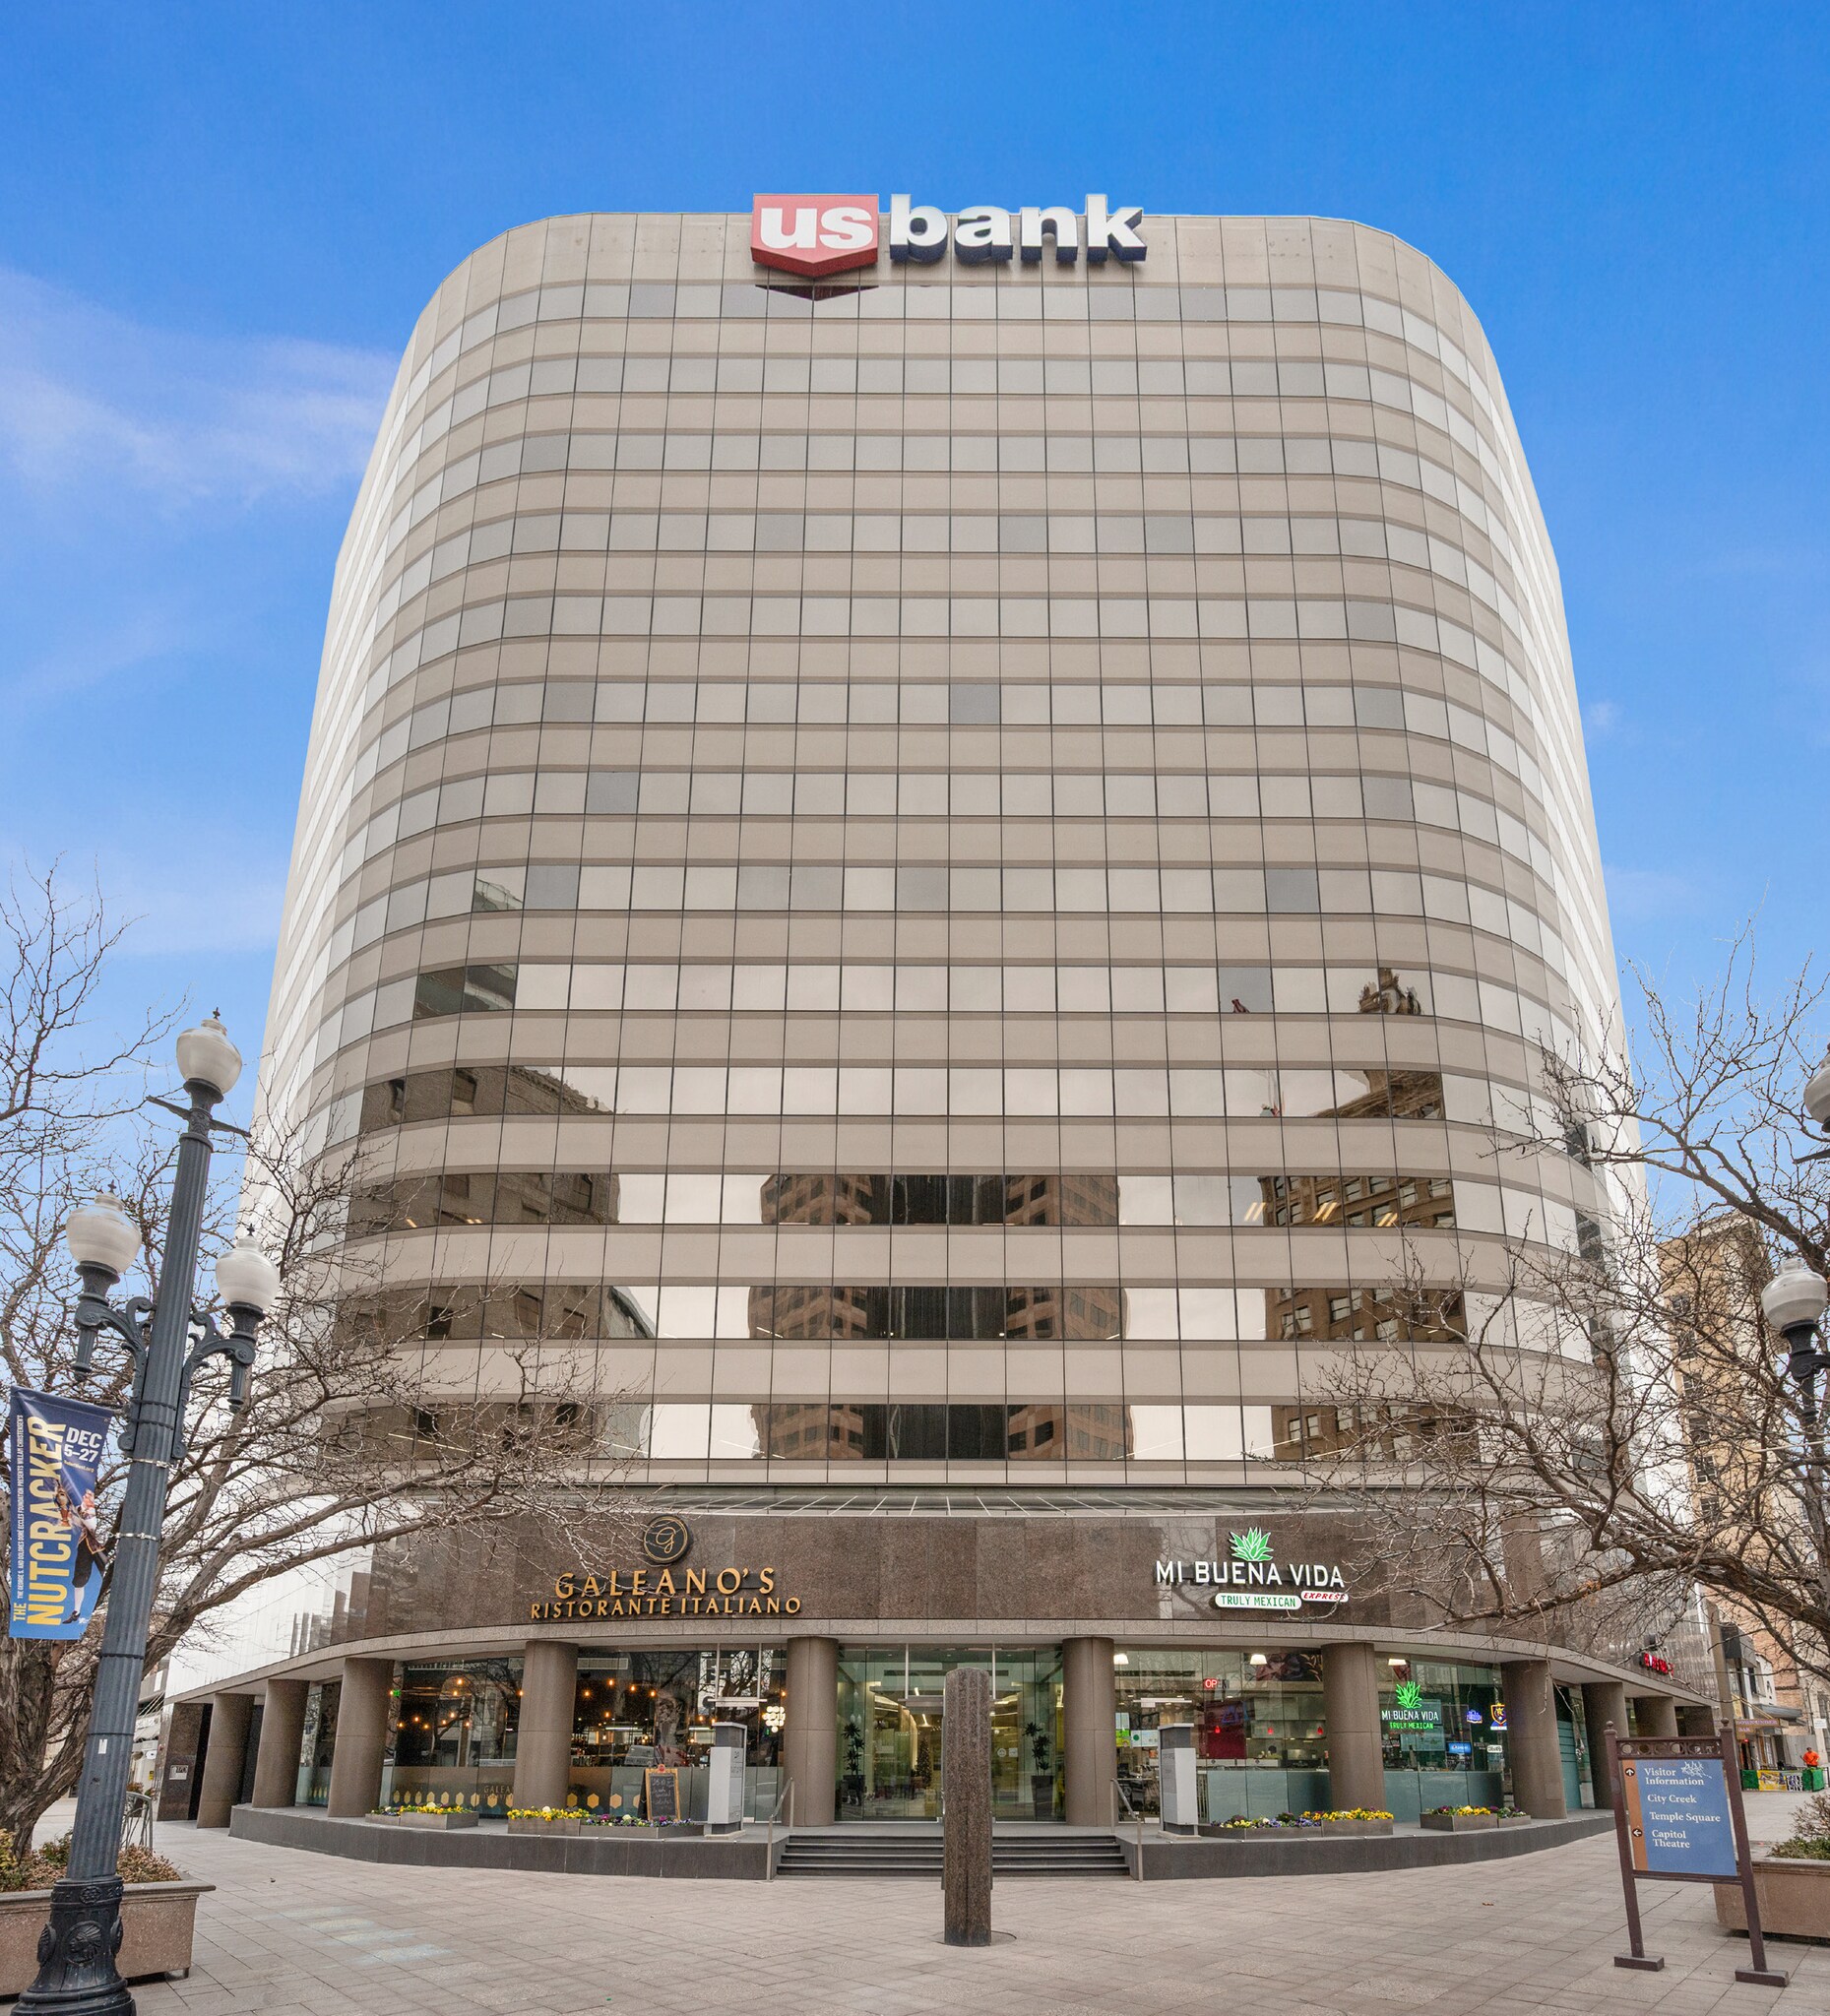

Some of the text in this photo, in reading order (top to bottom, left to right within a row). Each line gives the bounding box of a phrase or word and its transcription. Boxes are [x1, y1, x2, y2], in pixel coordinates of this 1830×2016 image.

[760, 194, 1147, 258] us bank
[66, 1427, 102, 1449] DEC
[27, 1416, 72, 1626] NUTCRACKER
[1156, 1560, 1345, 1588] MI BUENA VIDA
[554, 1567, 776, 1600] GALEANO'S
[1222, 1595, 1296, 1607] TRULY MEXICAN
[1303, 1592, 1346, 1601] EXPRESS
[13, 1603, 27, 1621] THE
[531, 1597, 801, 1619] RISTORANTE ITALIANO
[1382, 1710, 1438, 1721] MI BUENA VIDA
[1644, 1767, 1676, 1776] Visitor
[1646, 1777, 1704, 1786] Information
[483, 1785, 513, 1794] GALEA
[1647, 1794, 1697, 1804] City Creek
[1650, 1811, 1721, 1824] Temple Square
[1652, 1829, 1686, 1840] Capitol
[1653, 1838, 1690, 1849] Theatre
